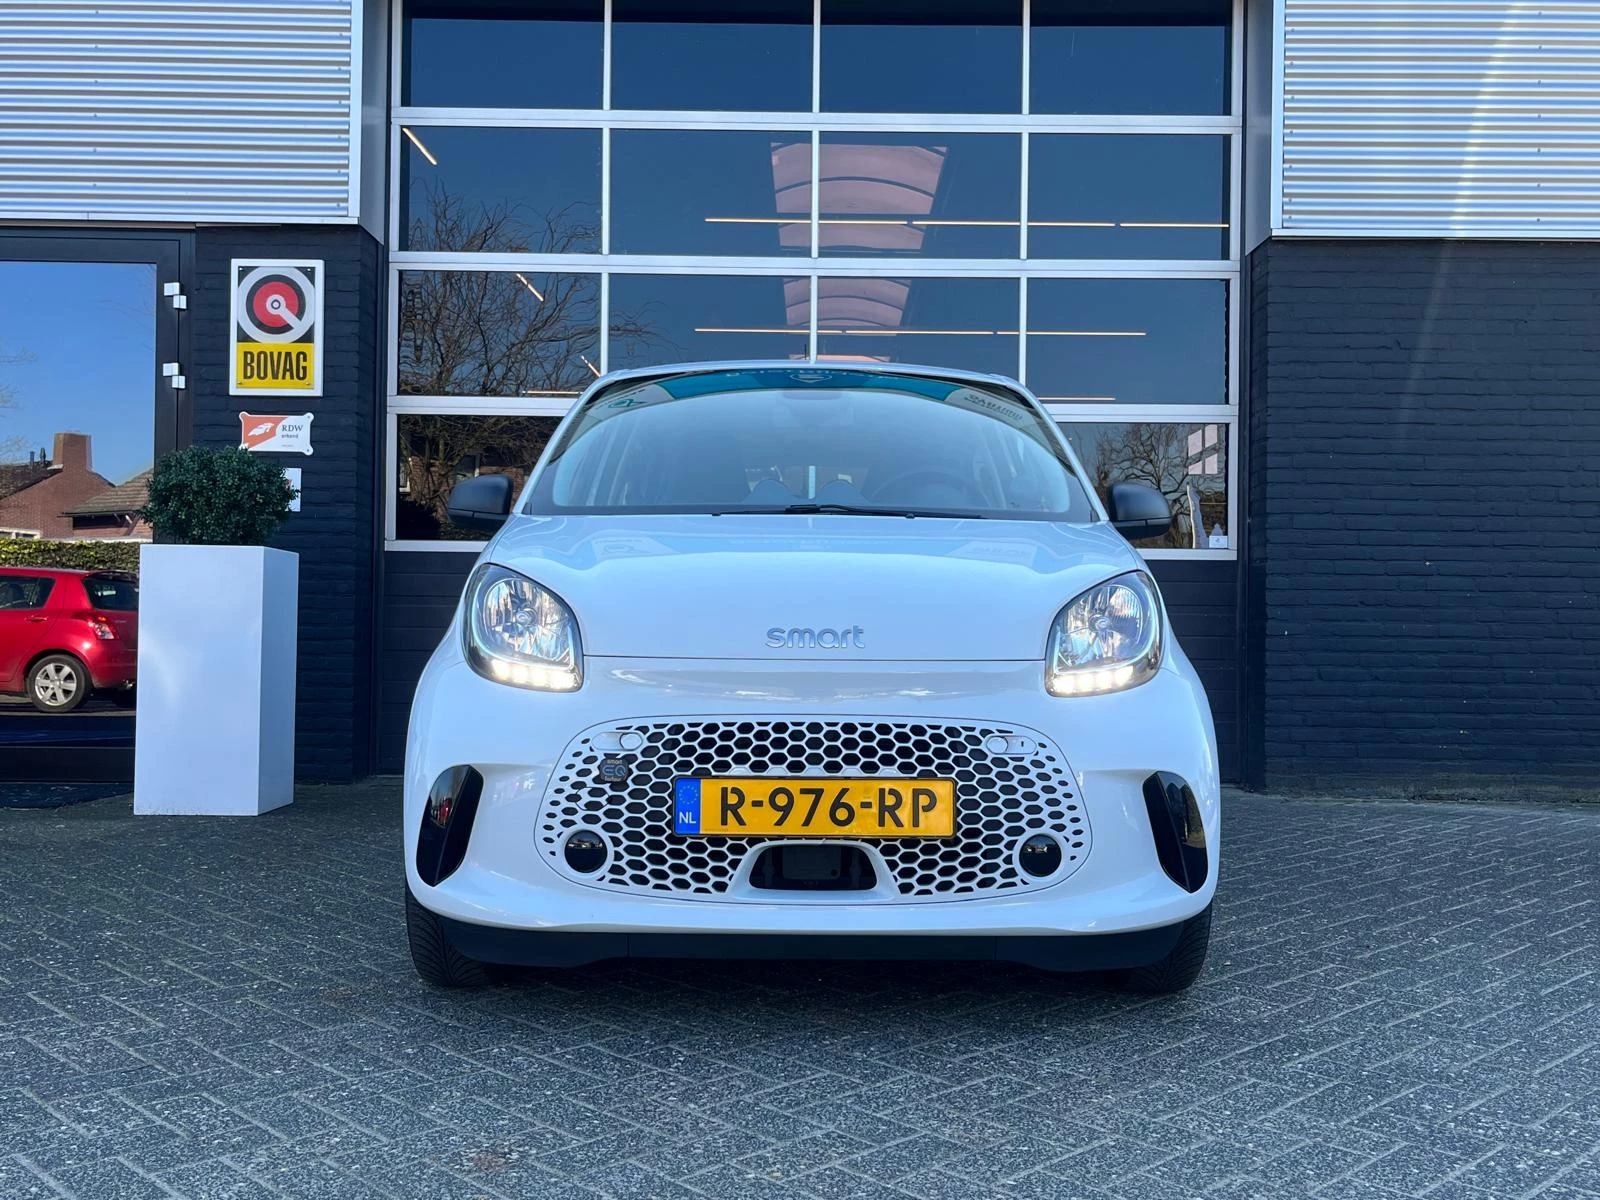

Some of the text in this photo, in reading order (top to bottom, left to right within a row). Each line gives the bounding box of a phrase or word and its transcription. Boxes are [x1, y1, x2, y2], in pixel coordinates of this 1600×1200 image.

[242, 350, 308, 381] BOVAG
[281, 424, 304, 432] RDW
[765, 625, 865, 649] smart
[602, 764, 626, 777] EQ
[720, 786, 938, 828] R-976-RP
[679, 811, 696, 824] NL
